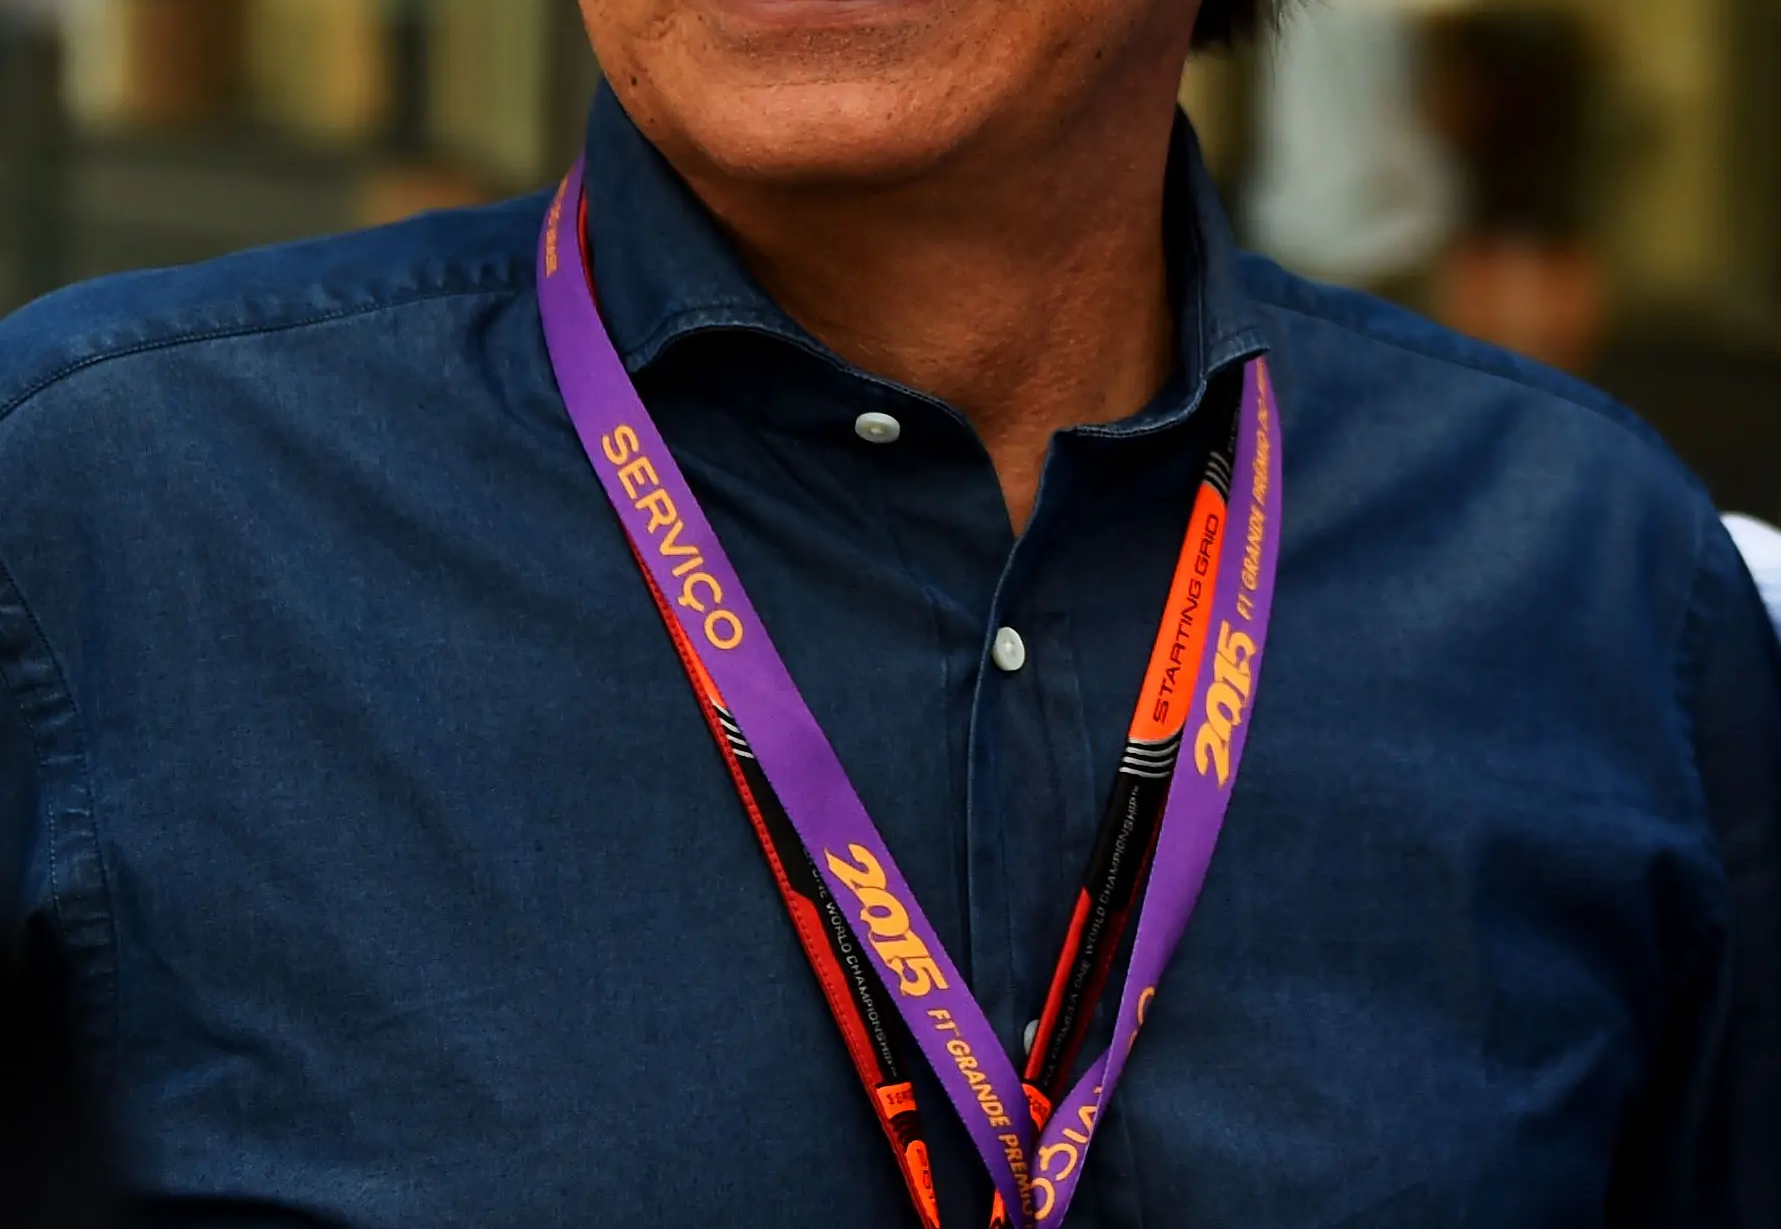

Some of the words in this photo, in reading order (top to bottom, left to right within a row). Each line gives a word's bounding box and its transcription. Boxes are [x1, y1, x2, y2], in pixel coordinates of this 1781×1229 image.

[601, 424, 744, 651] SERVIÇO
[1153, 580, 1202, 724] STARTING
[1198, 514, 1220, 576] GRID
[1194, 620, 1257, 790] 2015
[823, 843, 950, 997] 2015
[946, 1038, 1012, 1126] GRANDE
[826, 902, 852, 953] WORLD
